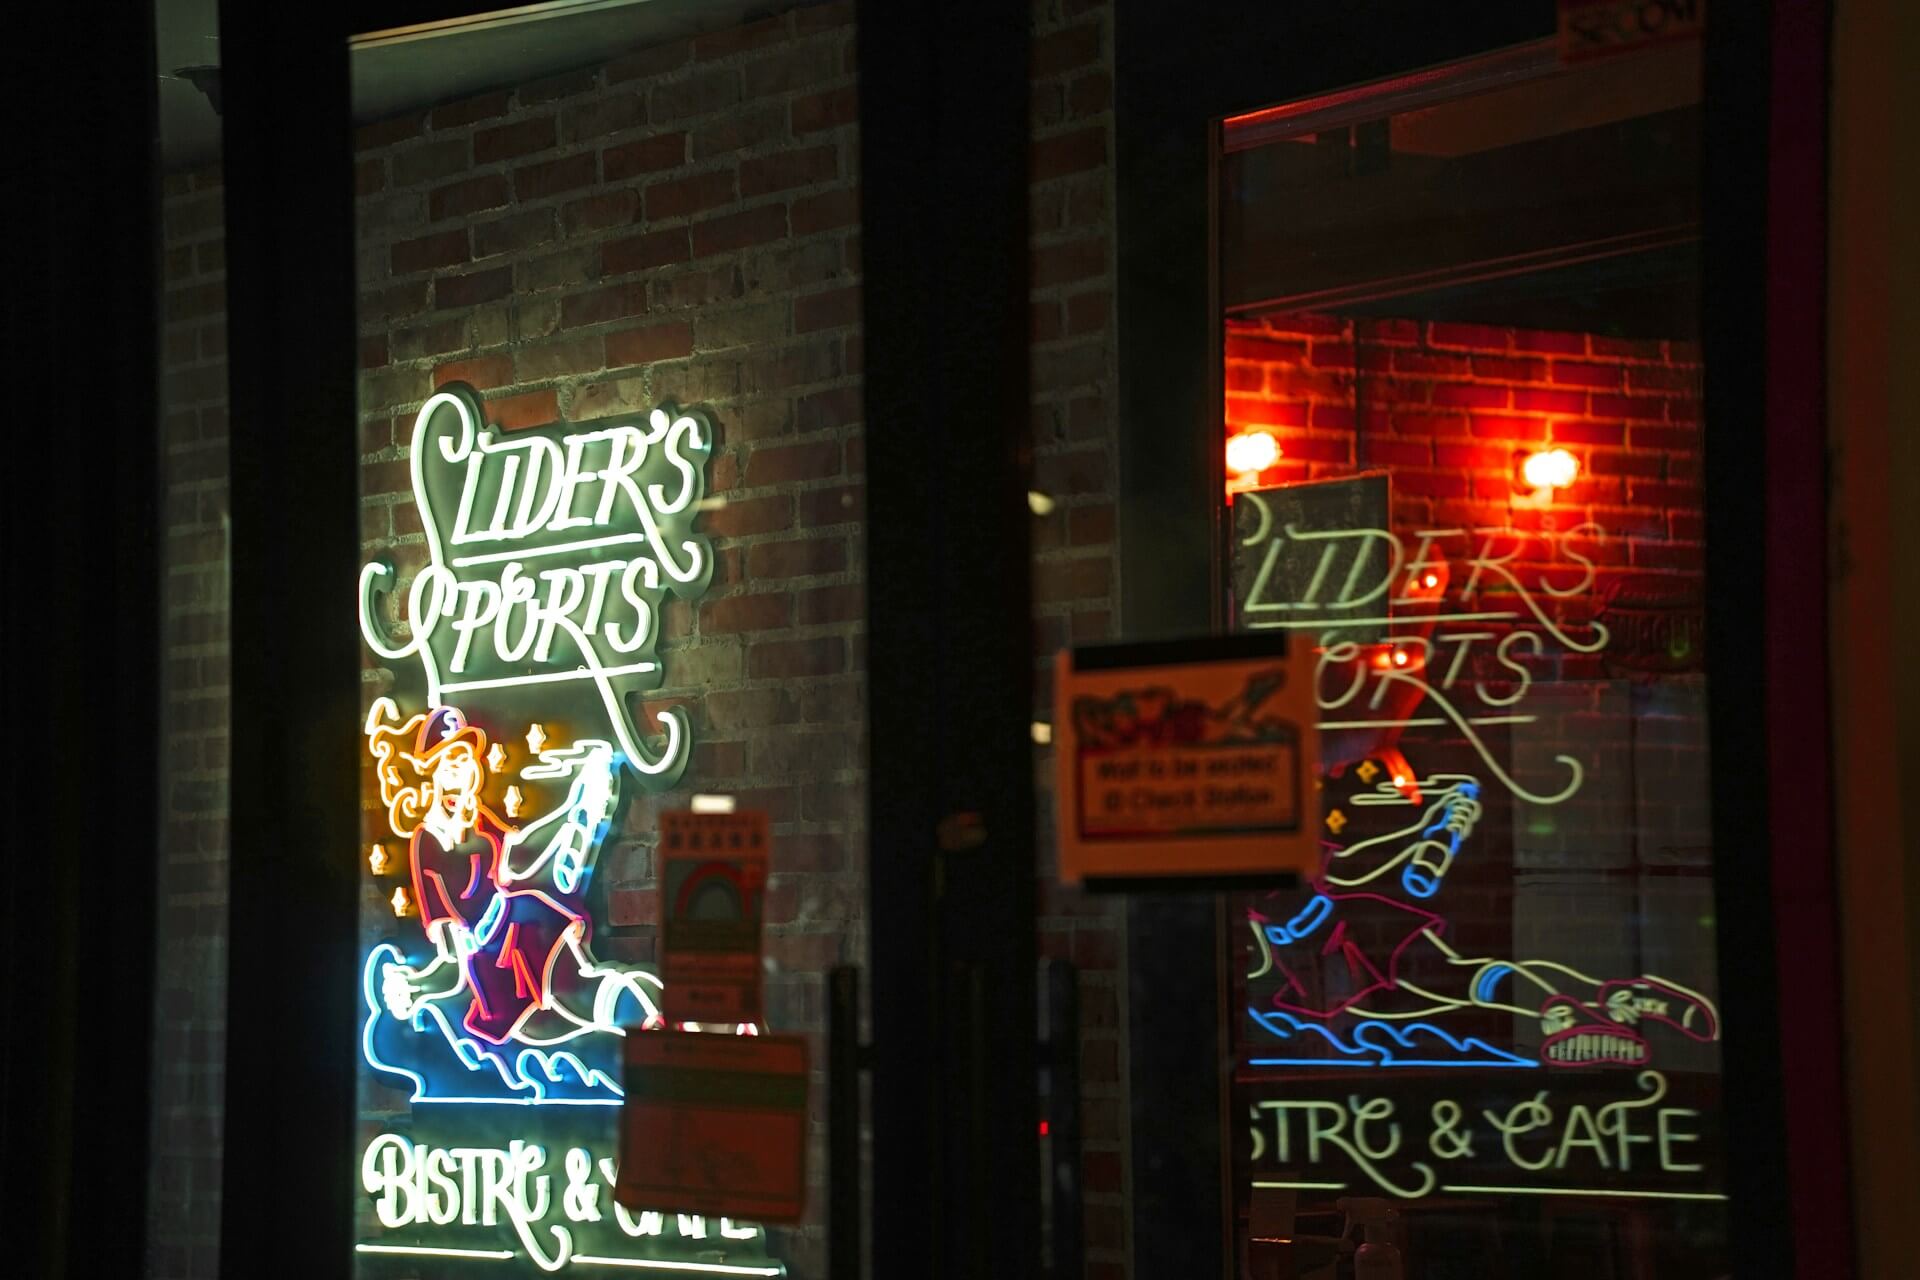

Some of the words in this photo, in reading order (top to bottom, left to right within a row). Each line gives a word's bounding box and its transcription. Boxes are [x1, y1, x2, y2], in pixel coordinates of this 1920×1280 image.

[410, 392, 704, 582] SLIDER'S
[1428, 1099, 1476, 1159] &
[1482, 1070, 1704, 1172] CAFE
[563, 1147, 601, 1222] &
